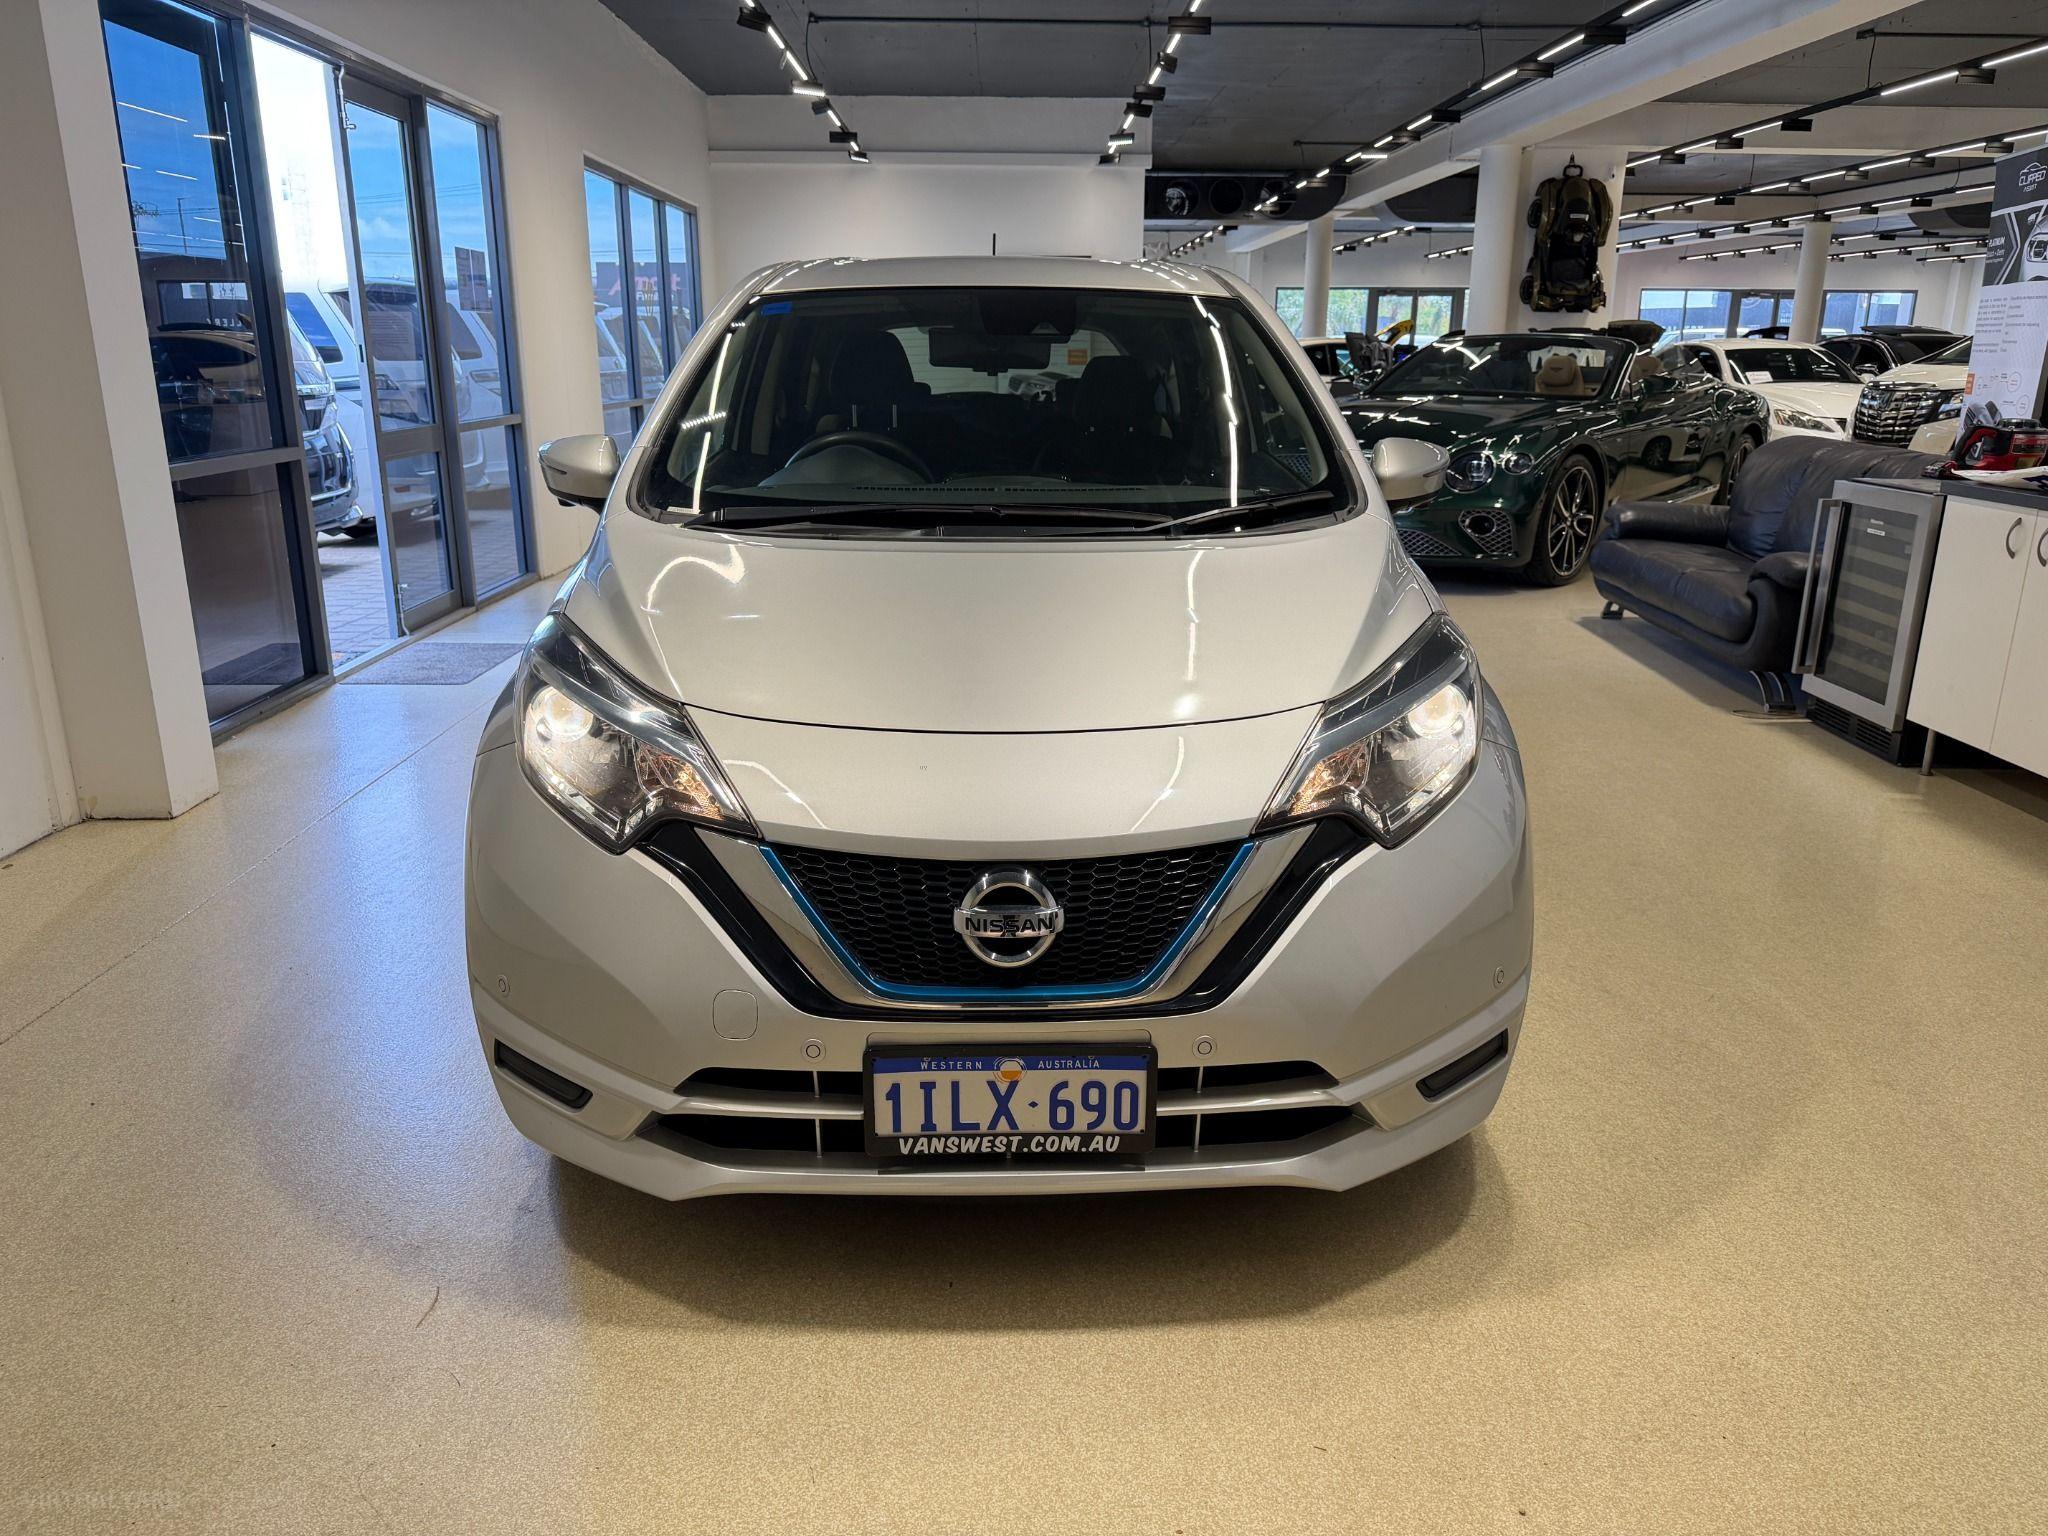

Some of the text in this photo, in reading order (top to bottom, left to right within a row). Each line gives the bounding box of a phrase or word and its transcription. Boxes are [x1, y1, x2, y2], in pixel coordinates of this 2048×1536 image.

[965, 916, 1055, 934] NISSAN
[920, 1058, 1100, 1071] WESTERN AUSTRALIA
[898, 1135, 1121, 1155] VANSWEST.COM.AU
